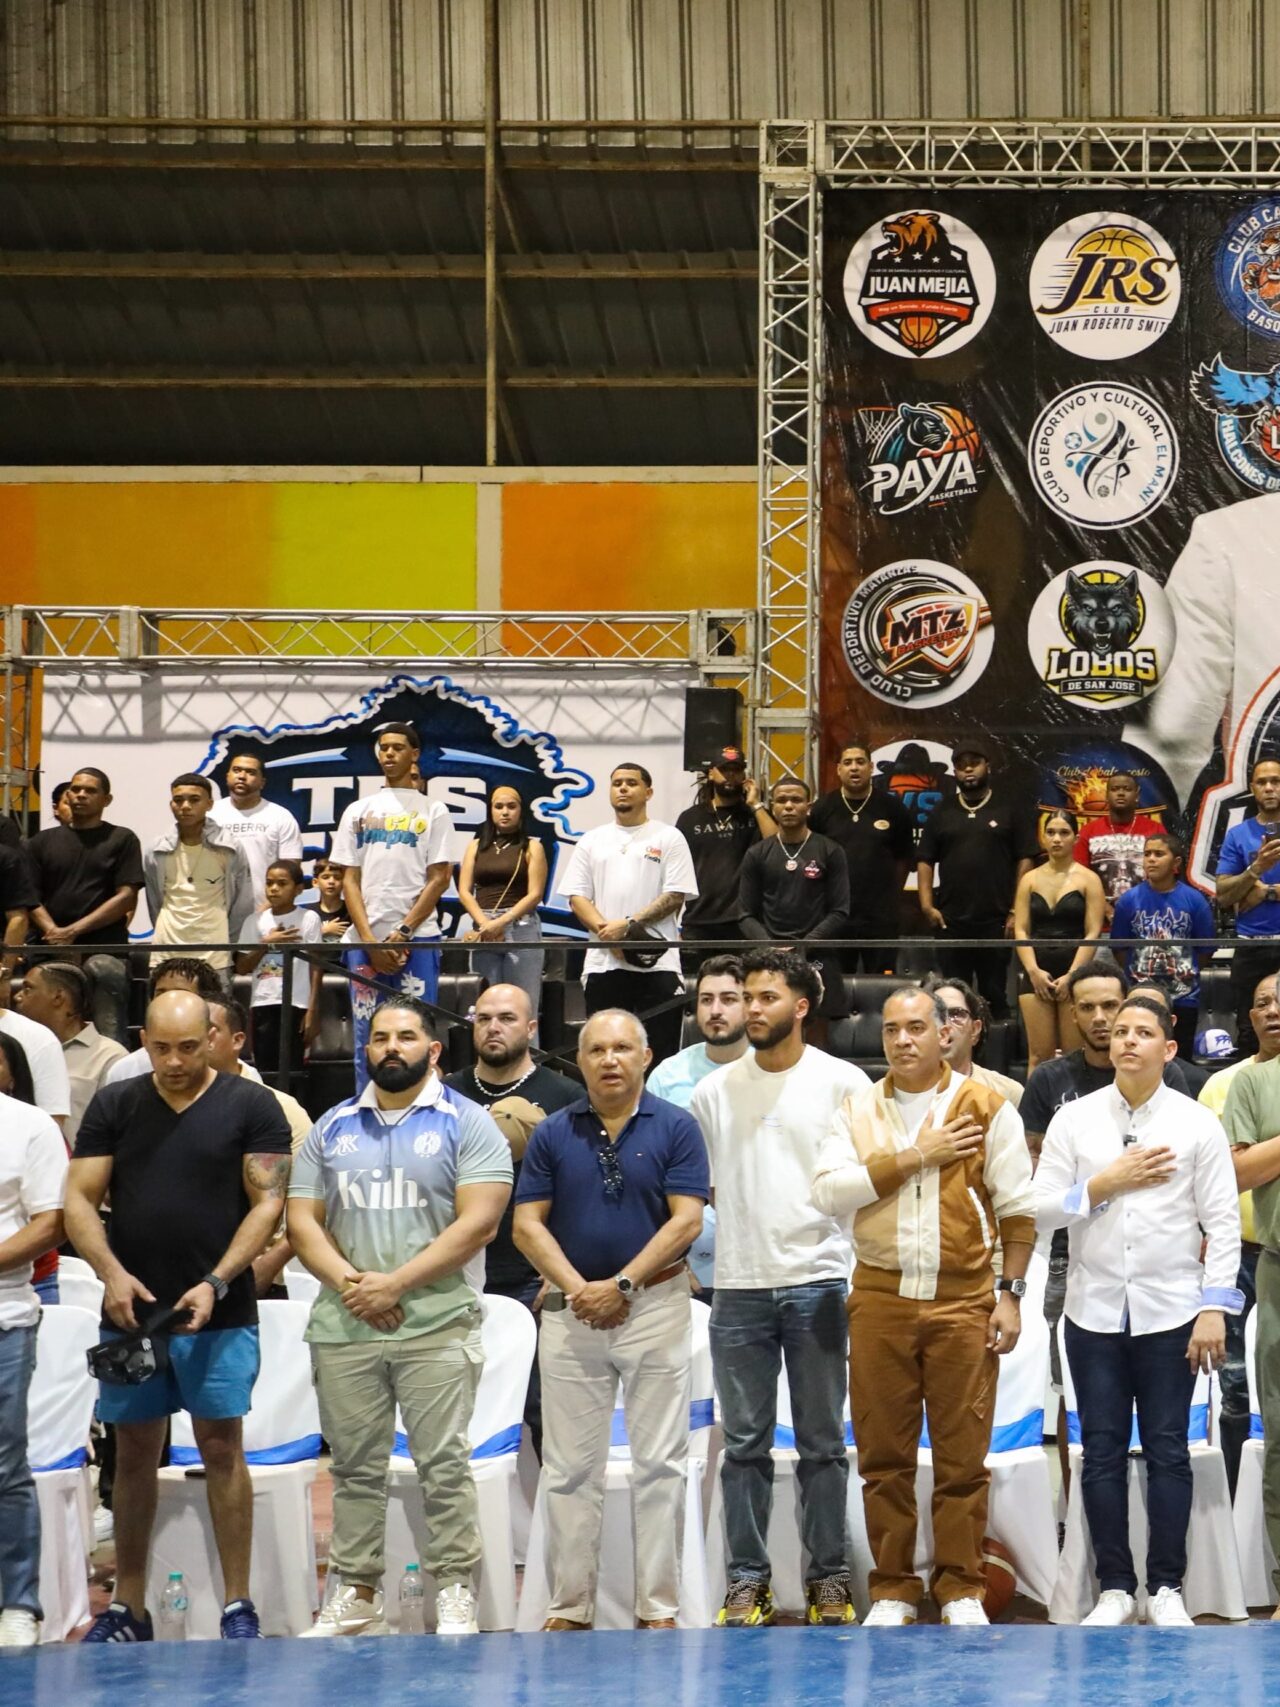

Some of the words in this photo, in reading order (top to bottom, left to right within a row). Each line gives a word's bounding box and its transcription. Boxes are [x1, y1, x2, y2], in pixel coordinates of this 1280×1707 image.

[1227, 214, 1262, 255] CLUB
[868, 276, 917, 297] JUAN
[918, 276, 971, 298] MEJIA
[1036, 253, 1179, 316] JRS
[1093, 305, 1131, 314] CLUB
[1048, 319, 1079, 335] JUAN
[1082, 317, 1134, 331] ROBERTO
[1091, 391, 1101, 403] Y
[1039, 395, 1087, 469] DEPORTIVO
[1103, 390, 1165, 444] CULTURAL
[1155, 443, 1168, 462] EL
[1221, 418, 1266, 486] HALCONES
[860, 451, 978, 515] PAYA
[929, 486, 978, 502] BASKETBALL
[1042, 470, 1070, 505] CLUB
[845, 600, 872, 675] DEPORTIVO
[859, 565, 919, 598] MATANZAS
[889, 606, 966, 648] MTZ
[896, 626, 969, 654] BASKETBALL
[1047, 649, 1157, 680] LOBOS
[1067, 680, 1083, 692] DE
[1083, 680, 1106, 692] SAN
[1108, 680, 1136, 692] JOSE
[1056, 765, 1081, 778] Club
[221, 822, 270, 833] RBERRY
[335, 1167, 429, 1211] Kith.
